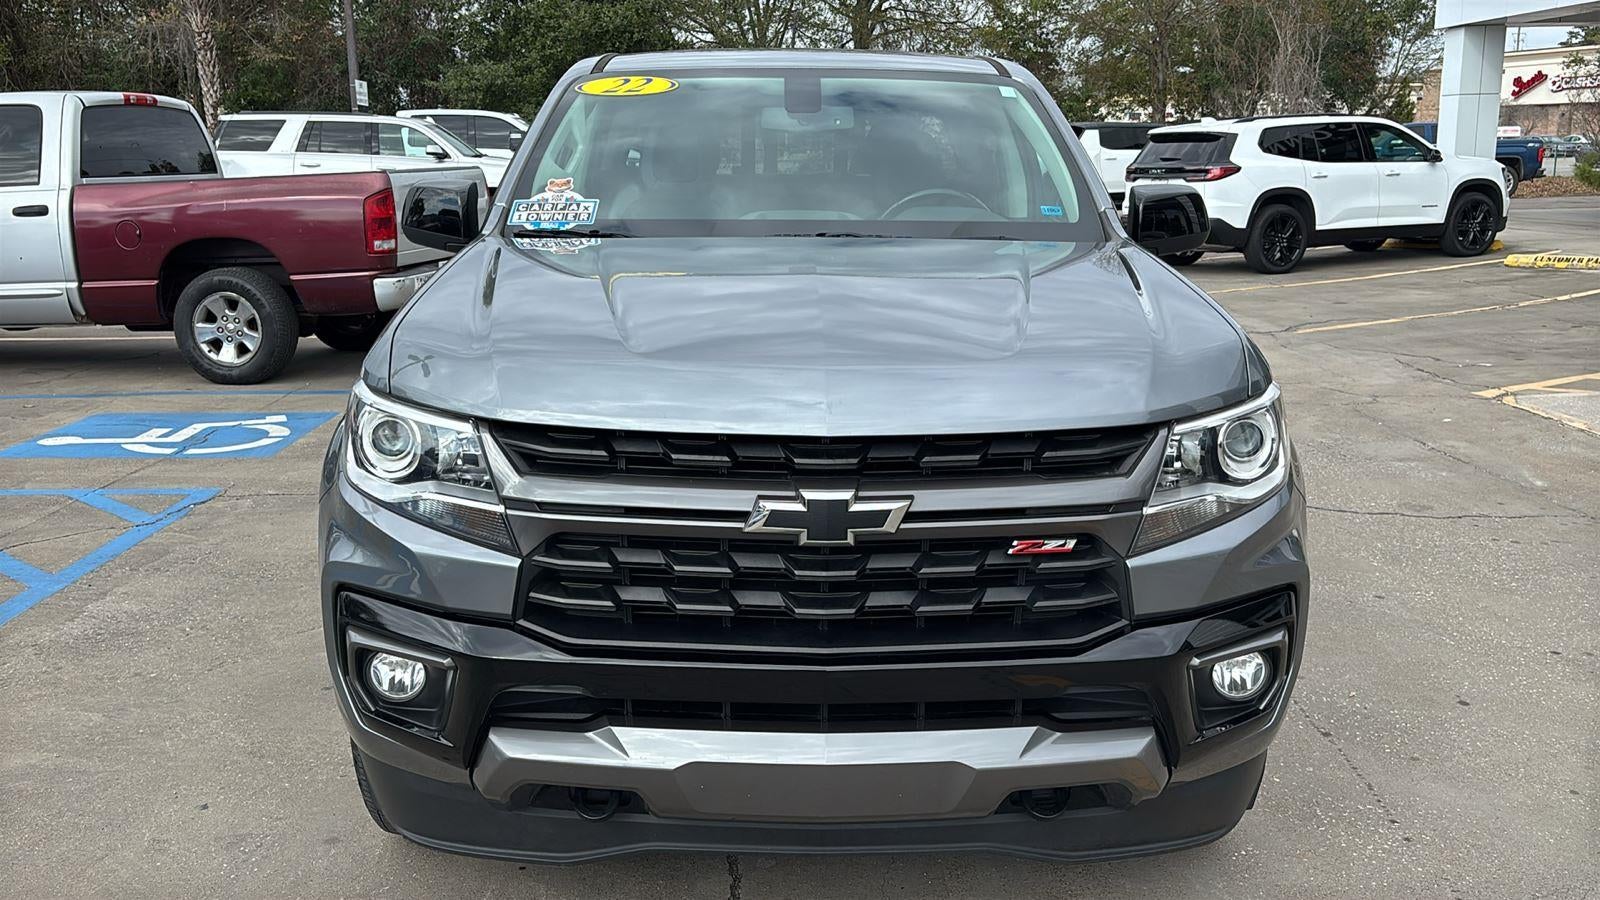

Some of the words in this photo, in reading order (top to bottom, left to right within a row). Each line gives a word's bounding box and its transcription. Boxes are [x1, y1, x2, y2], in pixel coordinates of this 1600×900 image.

[601, 78, 653, 93] 22
[518, 203, 591, 212] CARFAX
[1007, 539, 1077, 555] Z71
